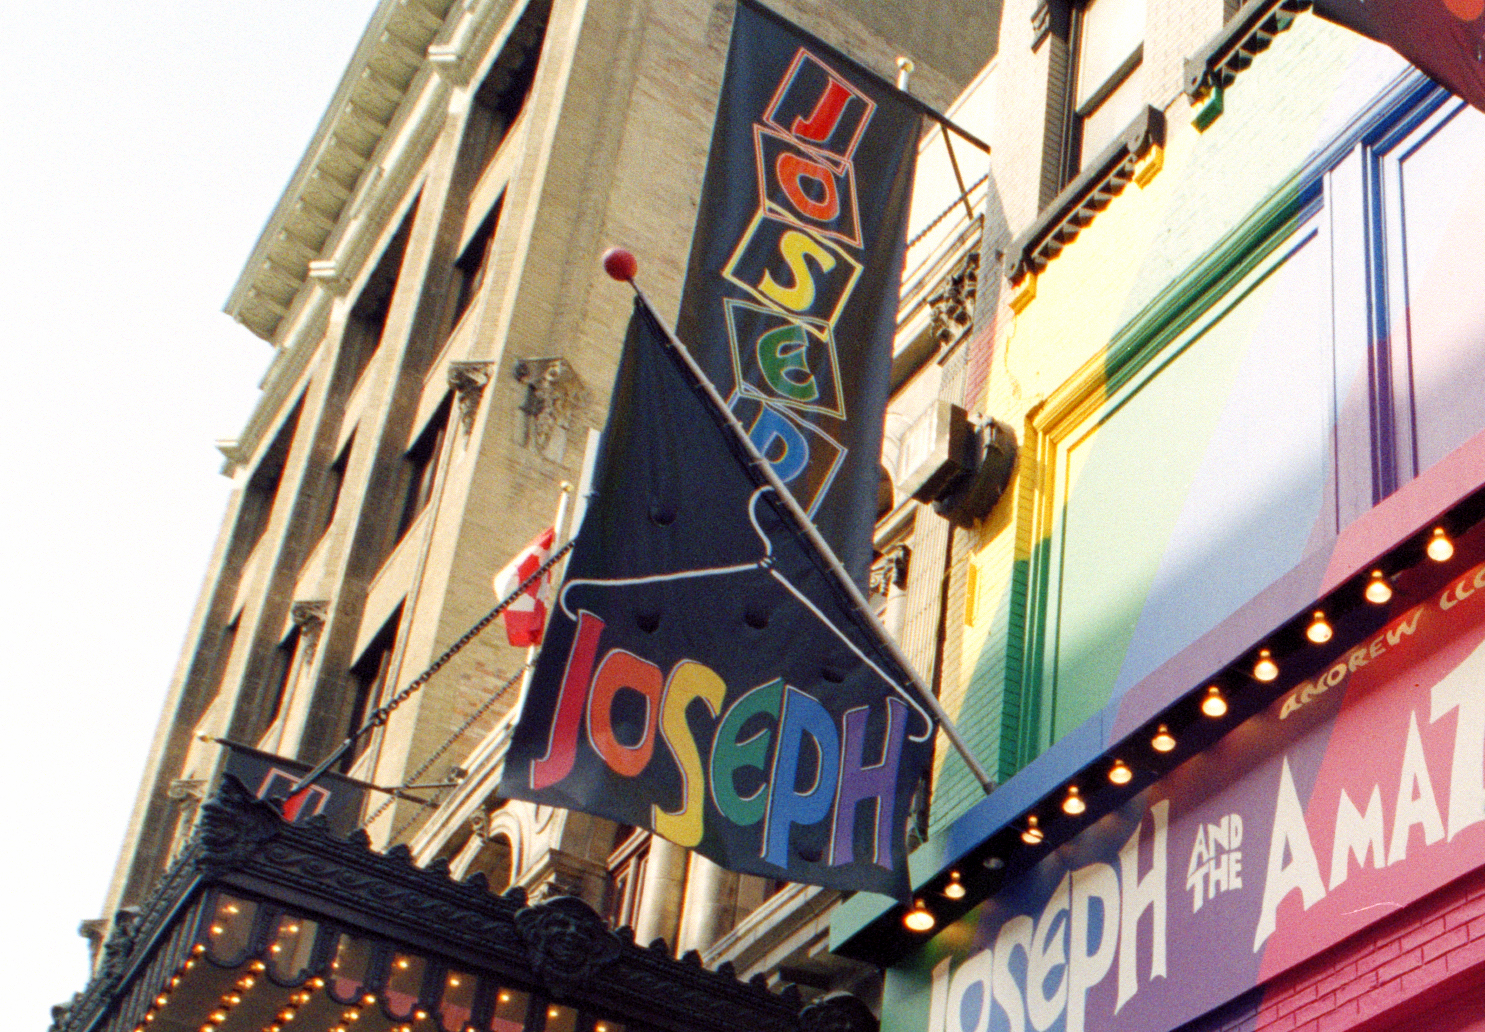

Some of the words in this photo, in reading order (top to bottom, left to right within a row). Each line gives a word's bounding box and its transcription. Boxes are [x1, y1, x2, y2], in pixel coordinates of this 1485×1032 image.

[530, 609, 908, 872] JOSEPH
[1187, 813, 1244, 879] AND
[1185, 851, 1243, 914] THE
